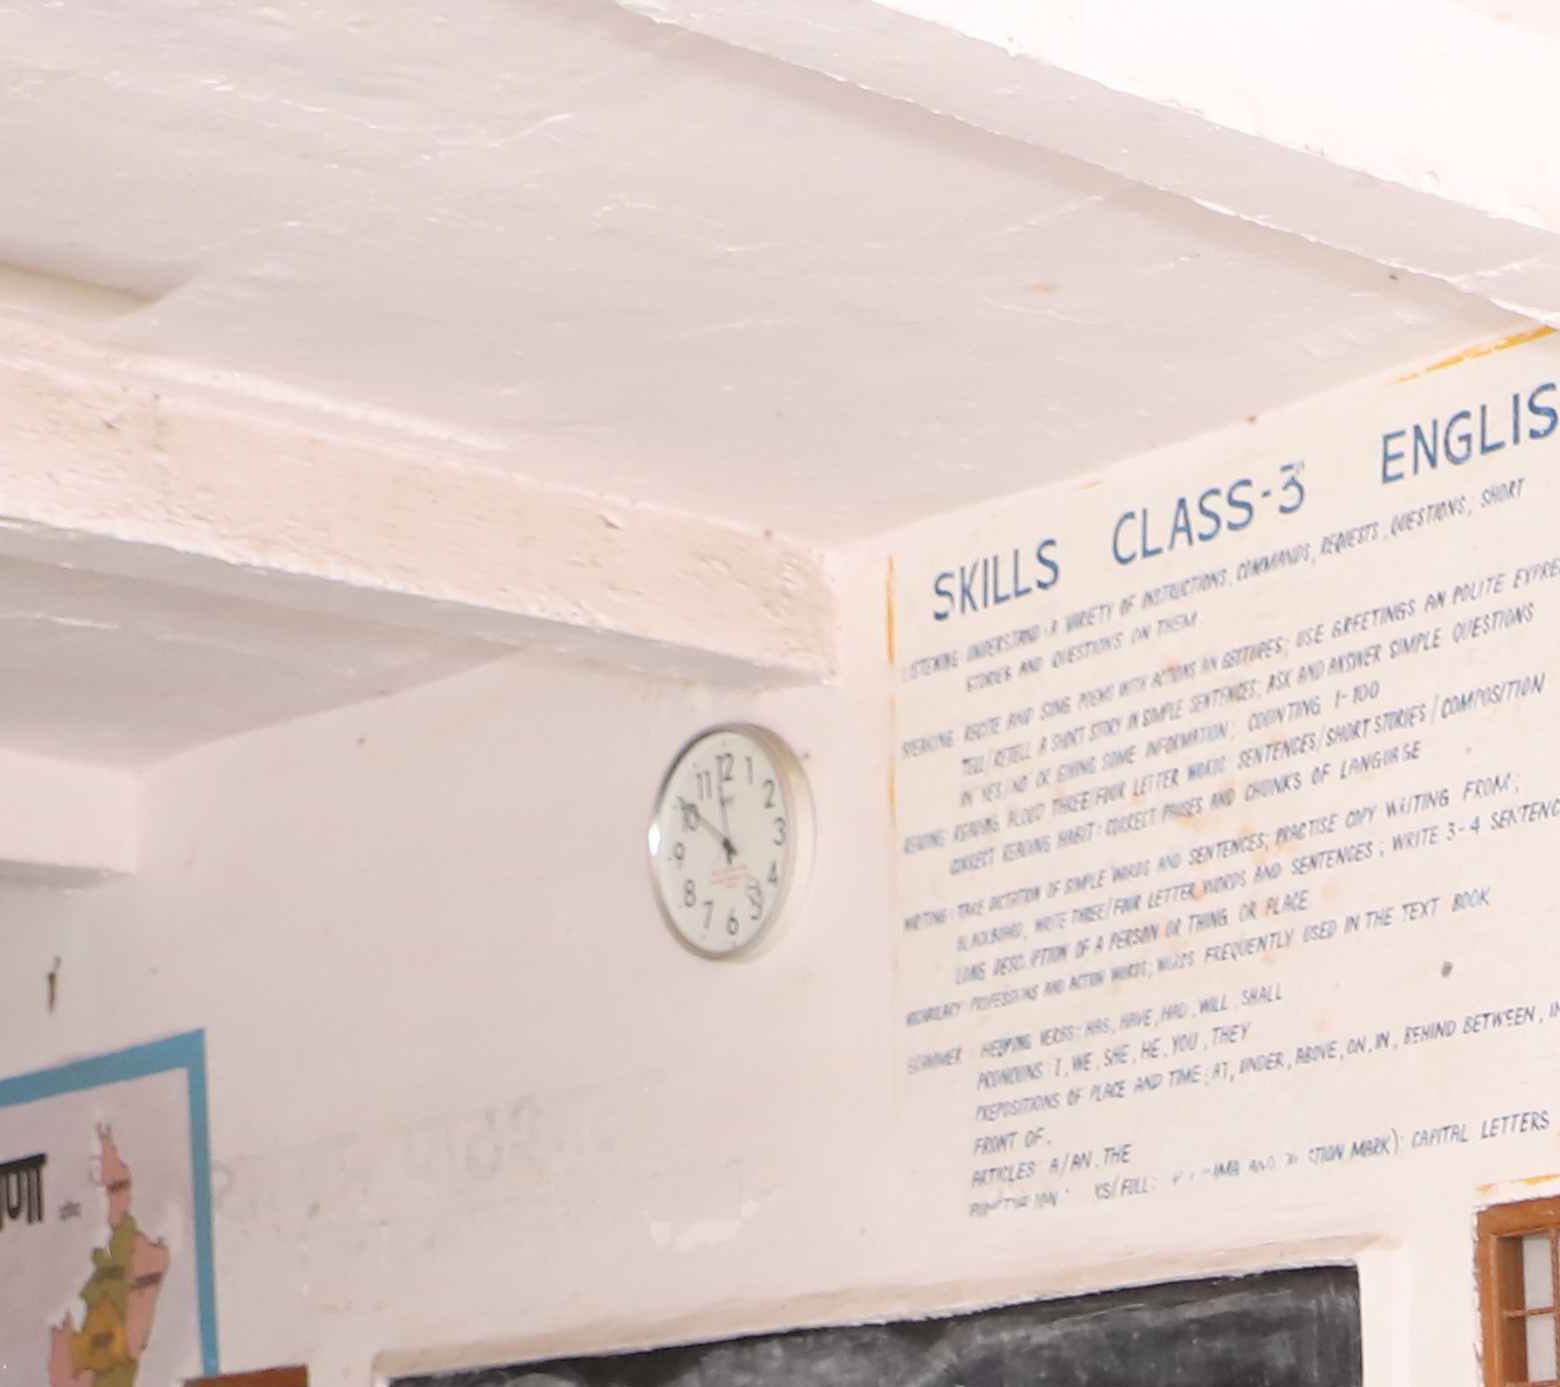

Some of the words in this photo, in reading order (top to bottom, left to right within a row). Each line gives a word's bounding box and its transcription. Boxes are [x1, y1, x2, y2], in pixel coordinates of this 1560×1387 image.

[933, 537, 1060, 621] SKILLS
[1112, 461, 1306, 566] CLASS-3
[1481, 1109, 1551, 1142] LETTERS
